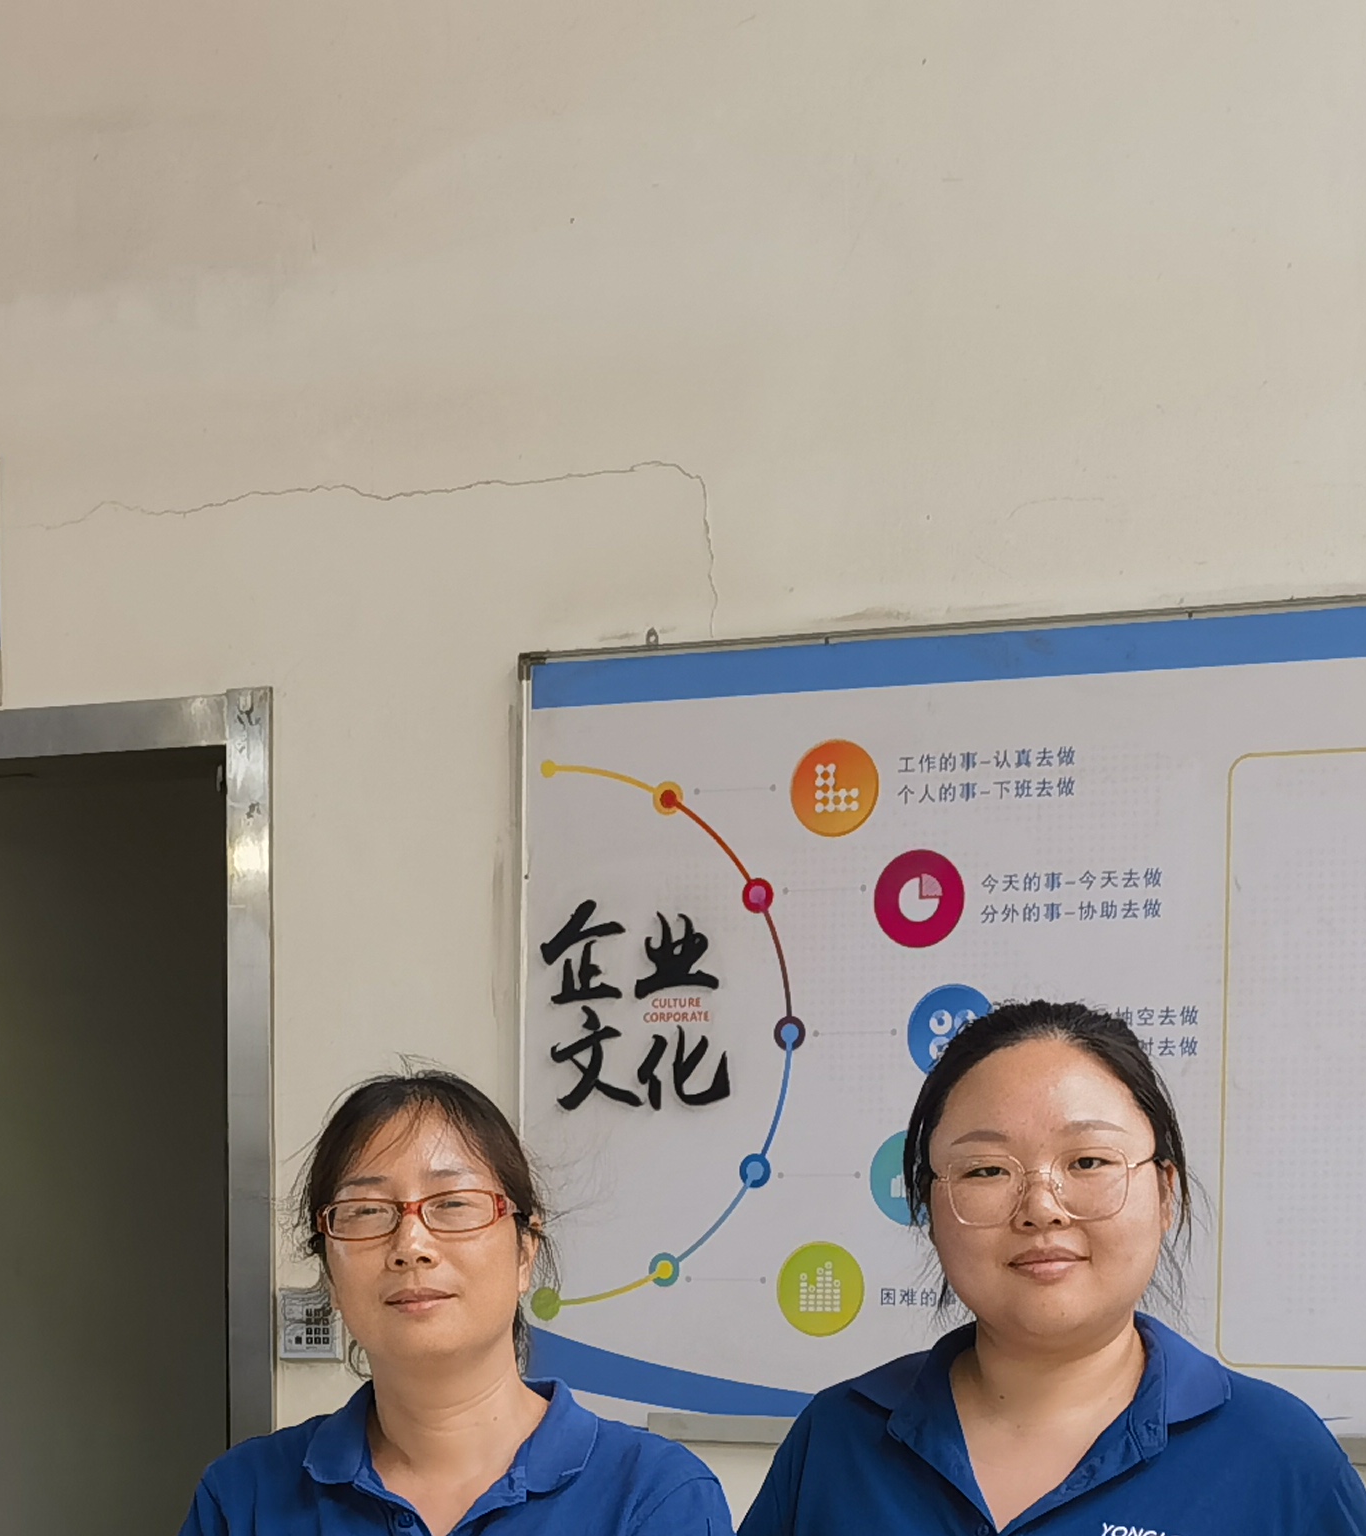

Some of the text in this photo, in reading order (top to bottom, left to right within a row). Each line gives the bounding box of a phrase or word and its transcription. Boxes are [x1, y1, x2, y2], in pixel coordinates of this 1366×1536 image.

[539, 899, 720, 1005] 企业
[643, 1010, 710, 1024] CORPORATE
[651, 997, 702, 1010] CULTURE
[550, 1005, 730, 1111] 文化
